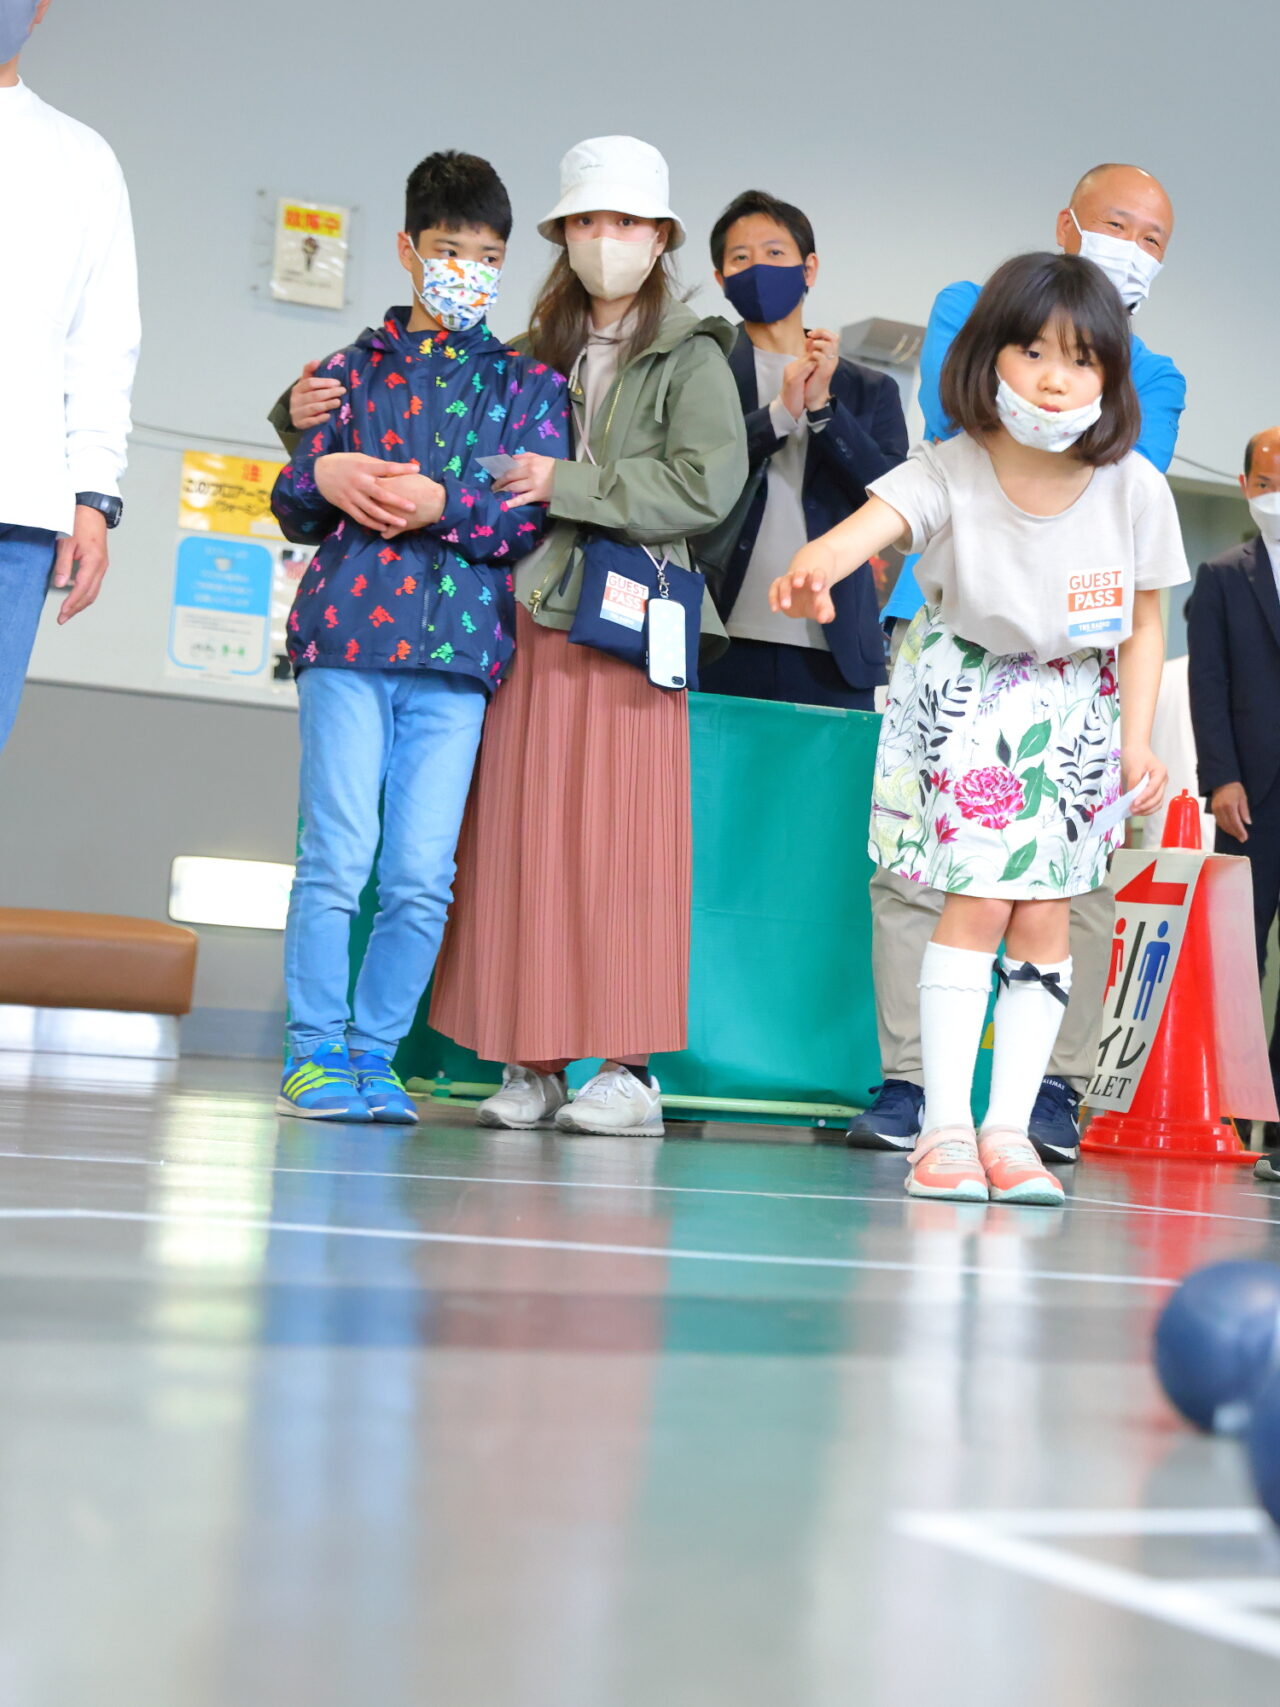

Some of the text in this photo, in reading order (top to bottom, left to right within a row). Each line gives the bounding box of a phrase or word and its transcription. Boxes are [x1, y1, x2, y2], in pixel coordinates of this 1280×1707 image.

[609, 575, 647, 597] GUEST
[1070, 570, 1122, 591] GUEST
[609, 589, 641, 610] PASS
[1074, 589, 1116, 611] PASS
[1098, 1024, 1146, 1070] イレ
